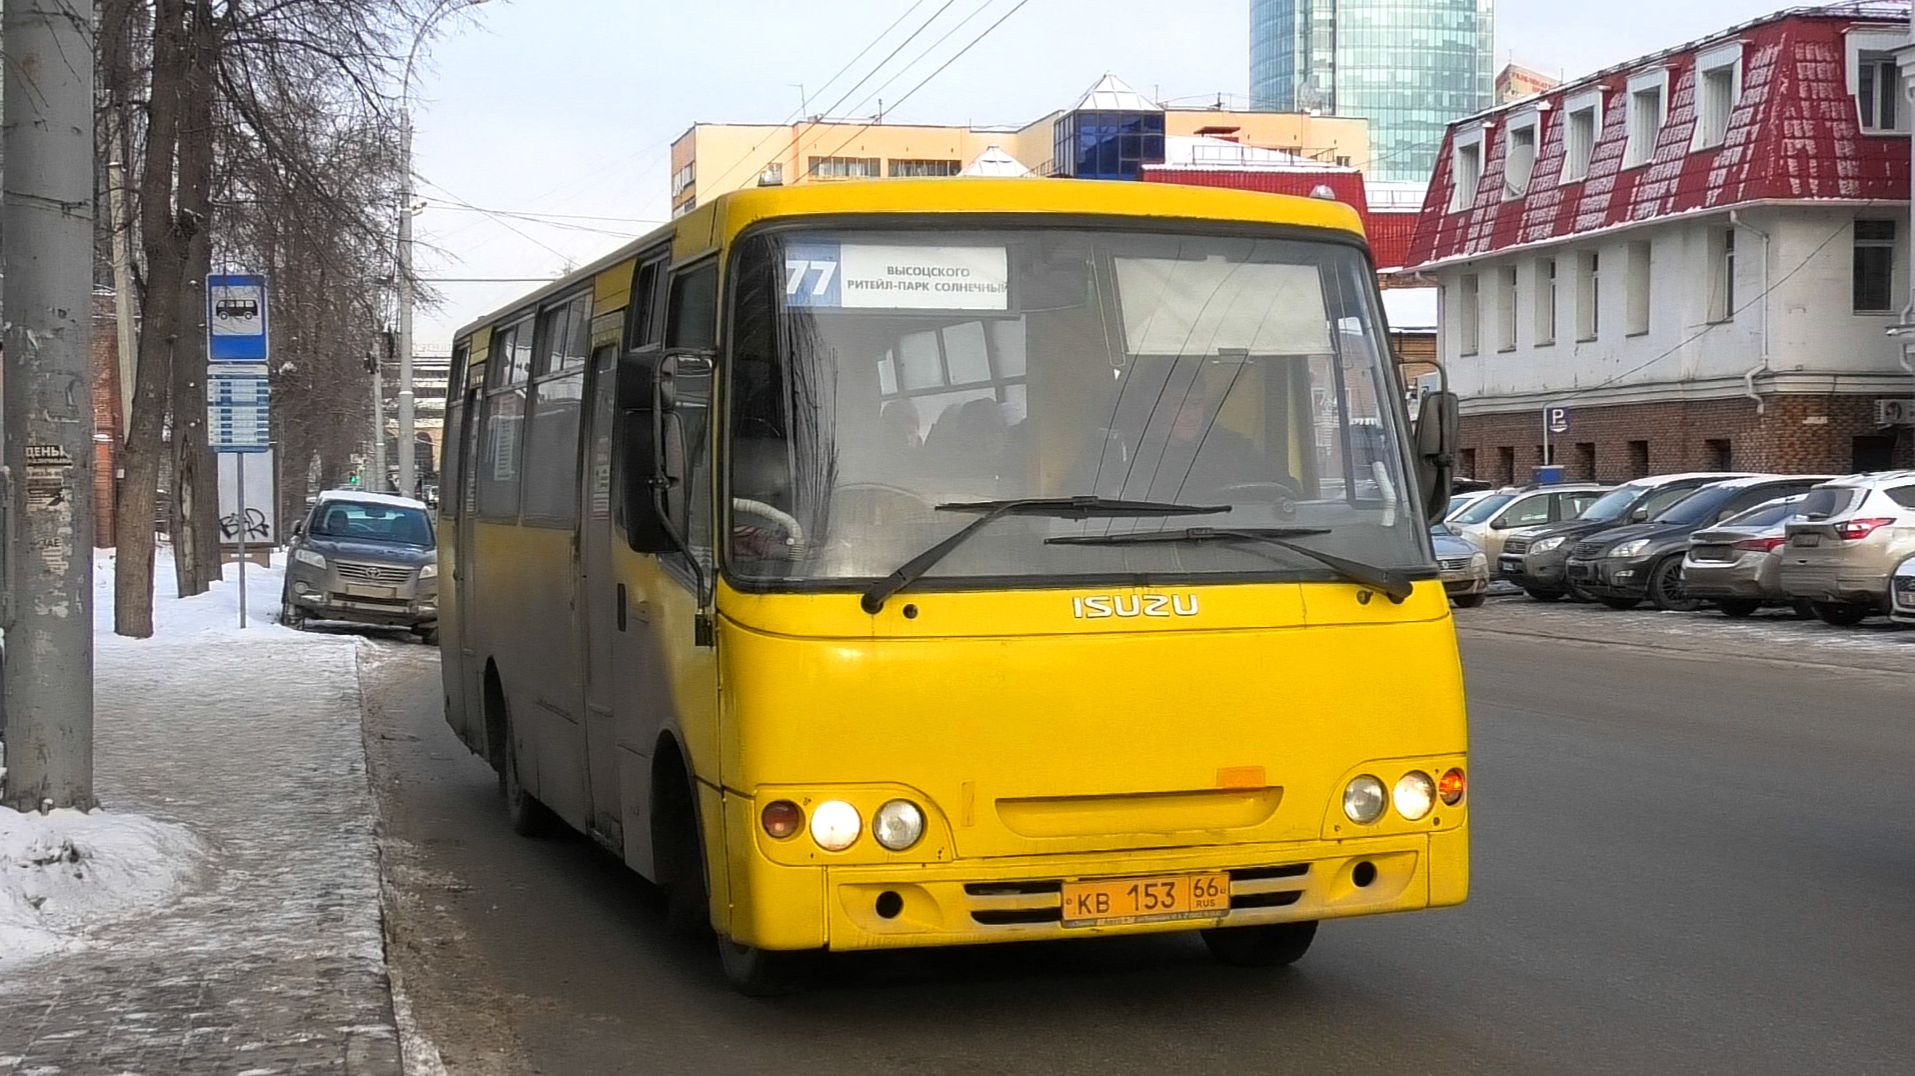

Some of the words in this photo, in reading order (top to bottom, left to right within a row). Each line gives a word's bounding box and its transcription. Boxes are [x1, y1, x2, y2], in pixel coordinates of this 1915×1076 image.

[785, 260, 837, 294] 77
[887, 265, 970, 278] ВЫСОЦСКОГО
[847, 279, 930, 292] РИТЕЙЛ-ПАРК
[934, 281, 1008, 293] СОЛНЕЧНЫЙ
[1552, 409, 1564, 424] P
[1072, 594, 1199, 618] ISUZU
[1127, 882, 1175, 911] 153
[1193, 878, 1219, 898] 66
[1196, 899, 1216, 908] RUS
